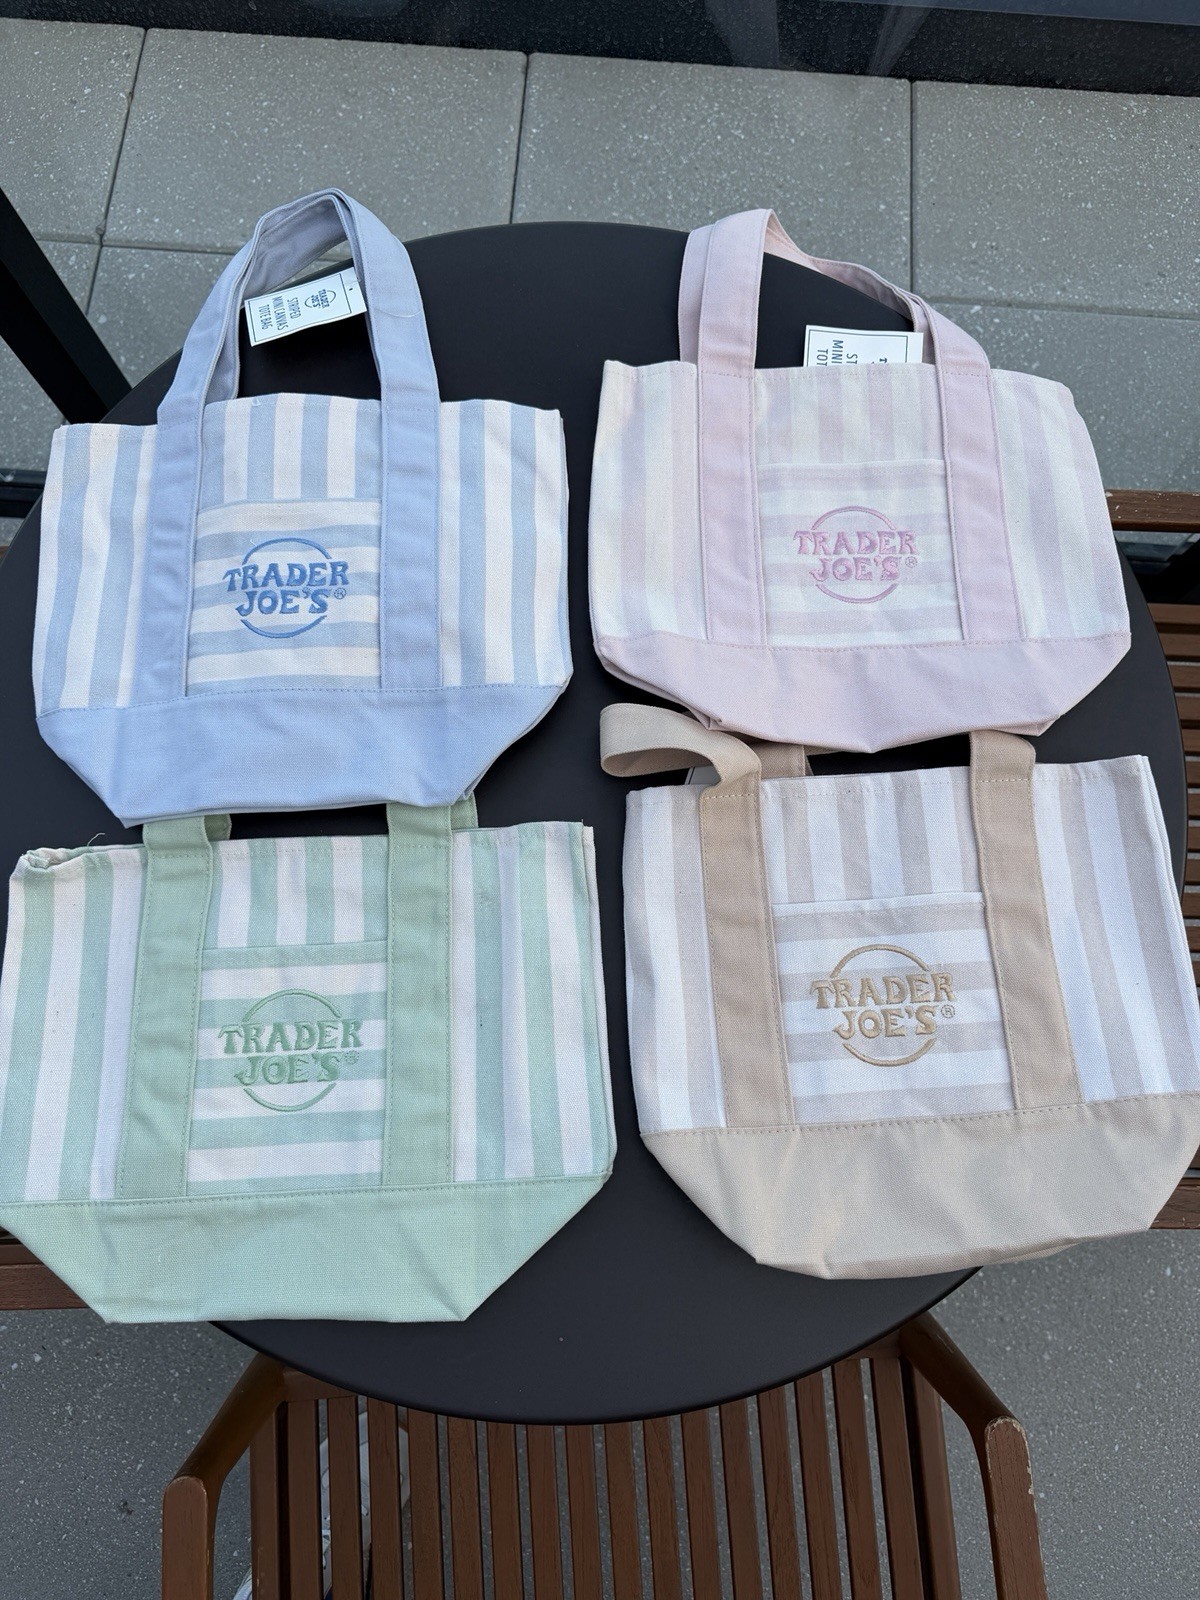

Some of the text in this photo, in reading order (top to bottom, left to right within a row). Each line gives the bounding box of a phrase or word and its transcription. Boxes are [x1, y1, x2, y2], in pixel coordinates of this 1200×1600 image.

[258, 304, 273, 330] TOTE BAG
[272, 296, 289, 331] MINI CANVAS
[286, 297, 302, 319] STRIPED
[816, 349, 828, 367] TOT
[831, 340, 844, 364] MINI
[793, 530, 919, 556] TRADER
[222, 561, 350, 592] TRADER
[809, 972, 956, 1009] TRADER
[218, 1019, 364, 1054] TRADER
